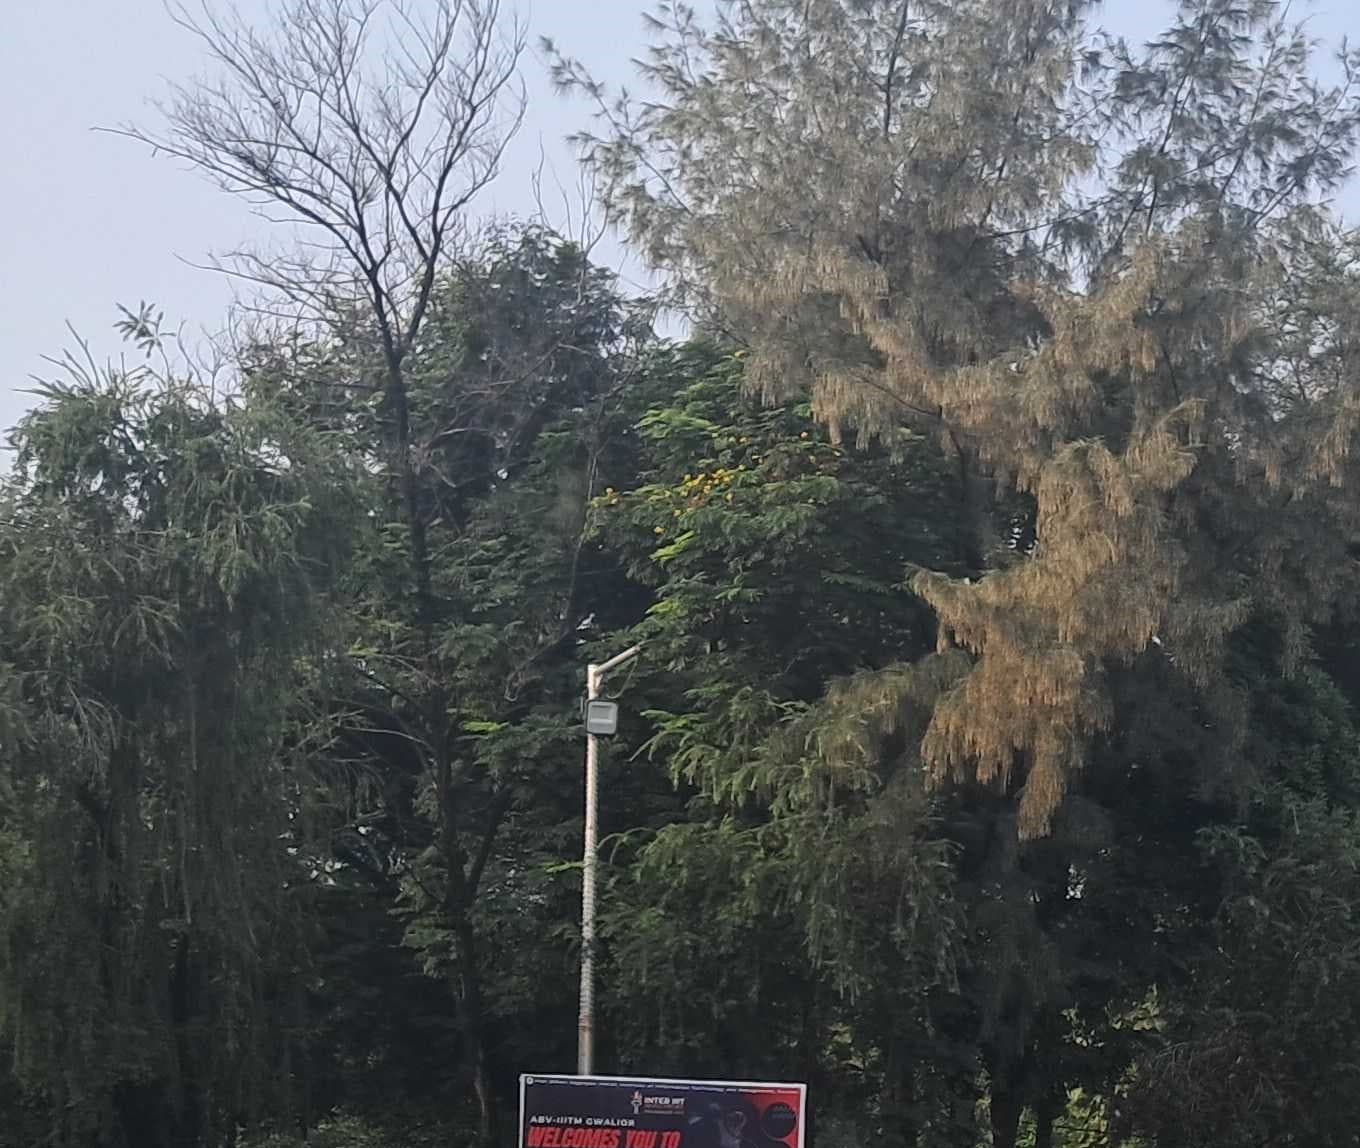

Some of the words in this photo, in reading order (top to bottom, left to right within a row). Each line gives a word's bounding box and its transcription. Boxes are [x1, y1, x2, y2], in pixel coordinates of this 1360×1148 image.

[530, 1116, 582, 1124] ABV-IIITM
[586, 1118, 635, 1126] GWALIOR
[527, 1127, 620, 1148] WELCOMES
